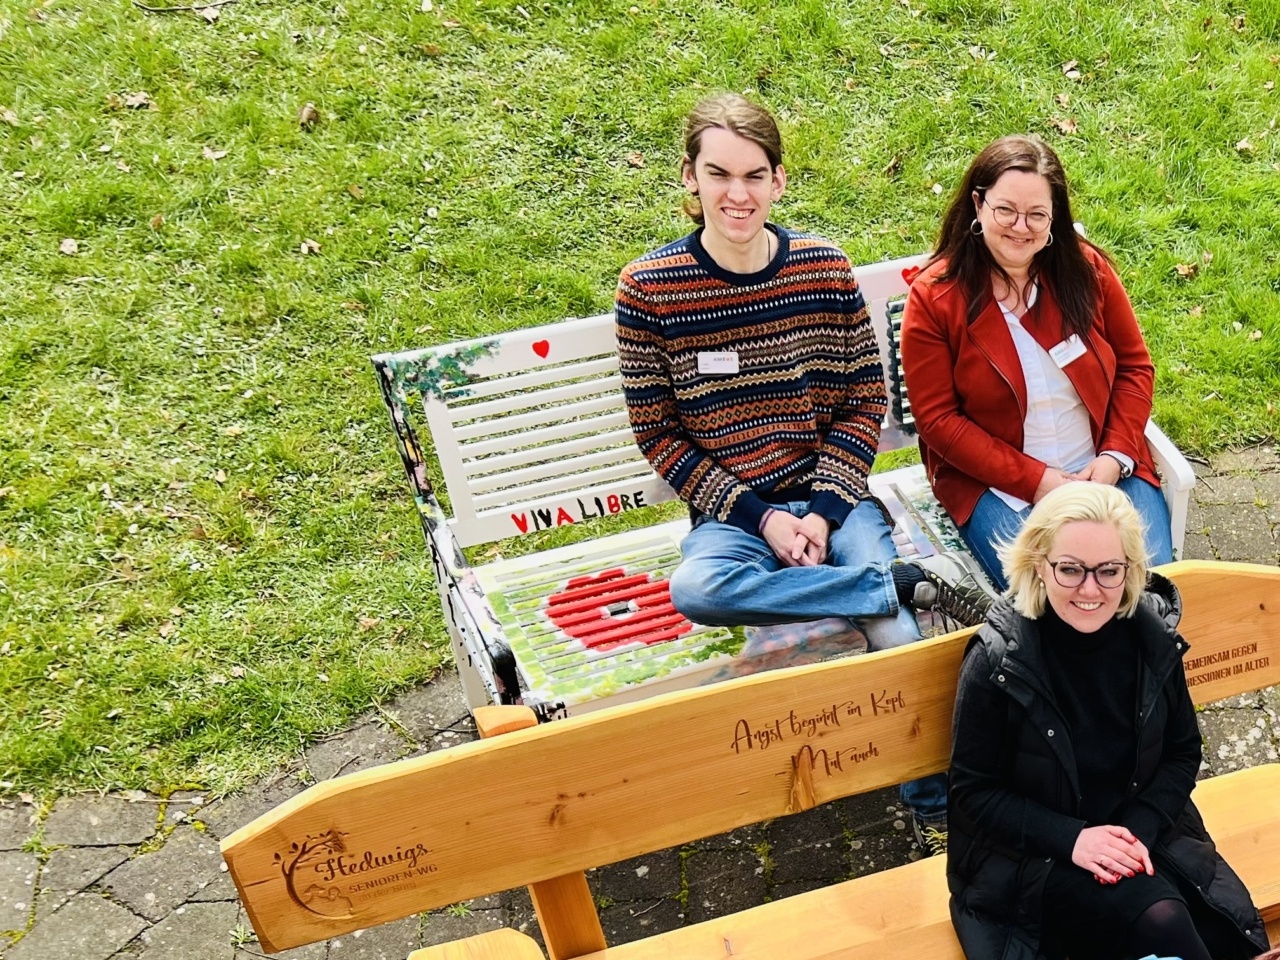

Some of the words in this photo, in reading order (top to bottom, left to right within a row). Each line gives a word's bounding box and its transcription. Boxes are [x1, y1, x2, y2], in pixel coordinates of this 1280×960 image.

[511, 506, 575, 534] VIVA
[576, 490, 648, 519] LIBRE
[1231, 642, 1258, 659] GEGEN
[1187, 666, 1232, 688] RESSIONEN
[1232, 663, 1243, 675] IM
[1244, 656, 1270, 673] ALTER
[731, 719, 784, 755] Angst
[789, 701, 854, 737] beginnt
[847, 706, 862, 717] im
[870, 689, 906, 716] Kopf
[791, 744, 845, 777] Mut
[850, 741, 880, 764] auch
[314, 843, 434, 881] Hedwigs
[349, 863, 438, 893] SENIOREN-WG
